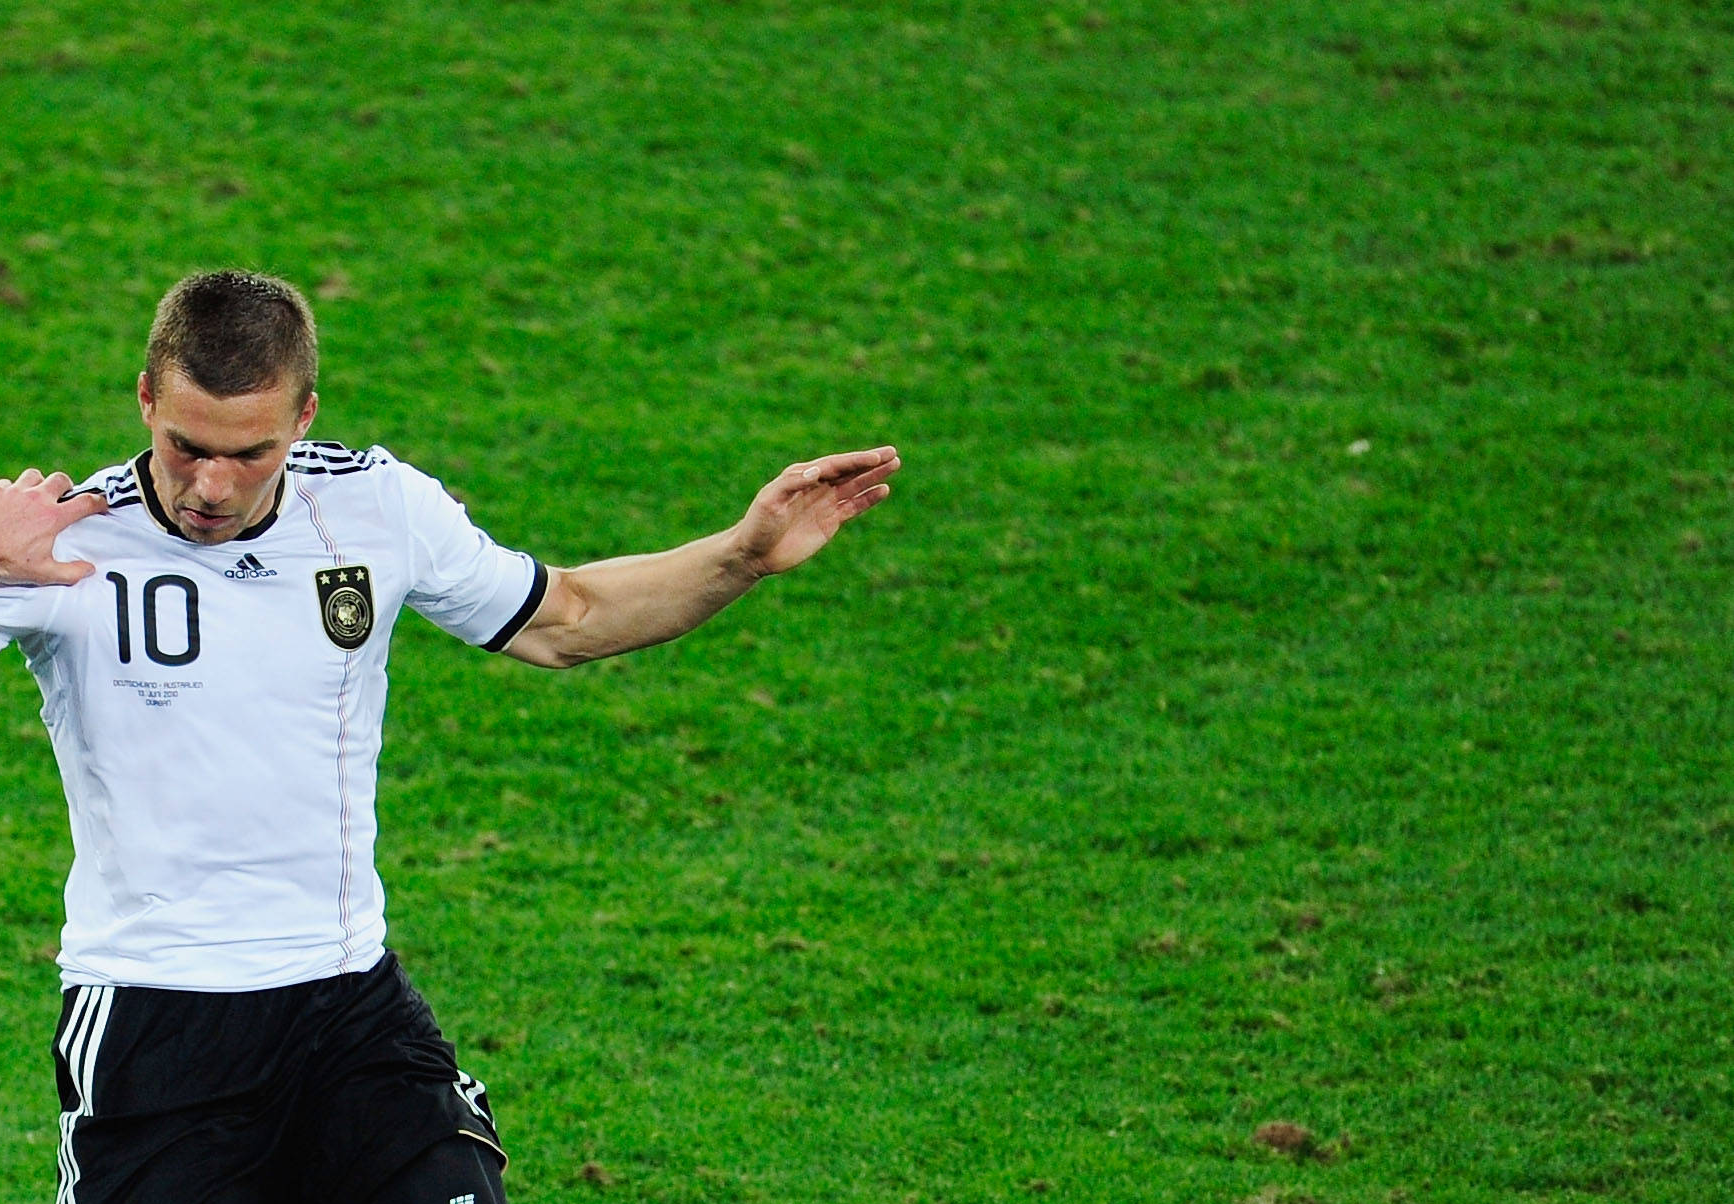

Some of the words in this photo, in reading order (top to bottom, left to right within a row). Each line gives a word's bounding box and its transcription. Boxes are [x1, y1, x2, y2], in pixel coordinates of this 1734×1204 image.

[224, 569, 278, 579] adidas
[106, 571, 201, 667] 10
[163, 681, 204, 689] AUSTRALIEN
[145, 699, 172, 707] DURBAN
